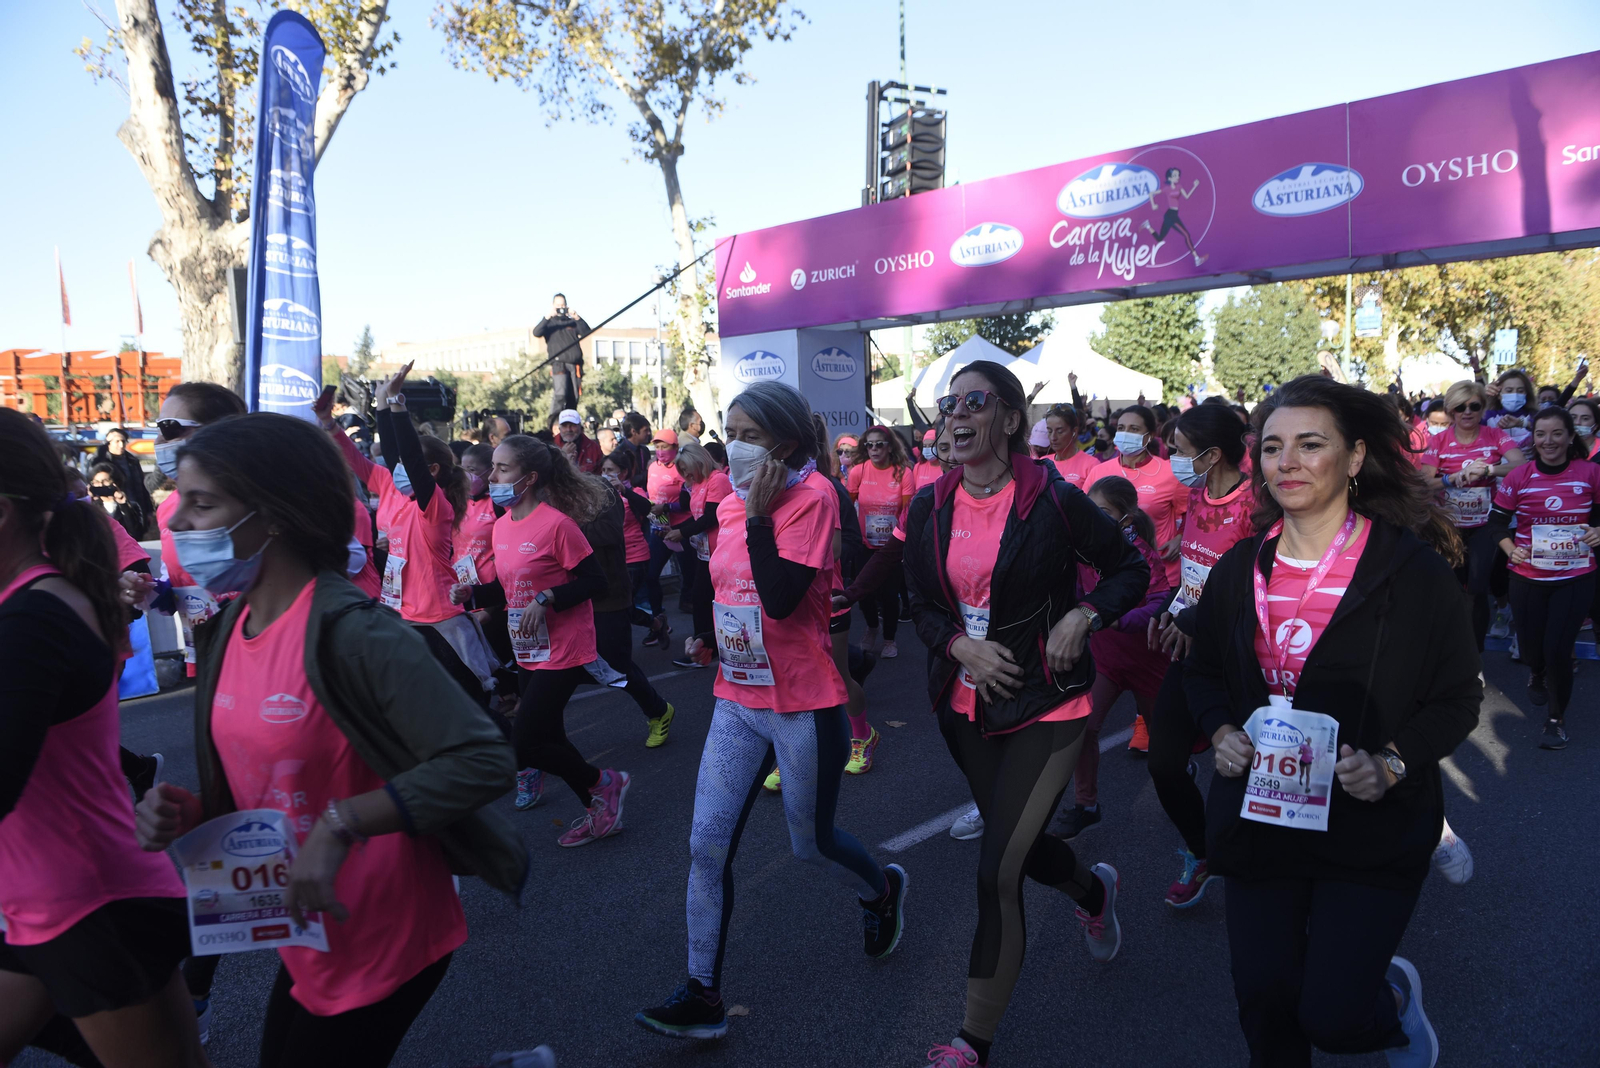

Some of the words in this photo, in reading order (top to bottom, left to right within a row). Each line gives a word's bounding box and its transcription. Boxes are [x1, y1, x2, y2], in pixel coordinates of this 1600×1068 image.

[1402, 149, 1519, 188] OYSHO
[1066, 182, 1150, 210] ASTURIANA
[1261, 182, 1355, 208] ASTURIANA
[1049, 217, 1133, 249] Carrera
[957, 240, 1017, 260] ASTURIANA
[1069, 245, 1085, 266] de
[1088, 243, 1100, 264] la
[1097, 233, 1166, 281] Mujer
[874, 250, 935, 275] OYSHO
[811, 264, 856, 284] ZURICH
[726, 281, 771, 299] Santander
[738, 365, 782, 378] ASTURIANA
[815, 359, 854, 373] ASTURIANA
[1531, 516, 1578, 525] ZURICH
[1550, 542, 1573, 551] 016
[515, 580, 533, 588] POR
[736, 579, 757, 590] POR
[1186, 584, 1201, 601] 016
[511, 629, 531, 640] 016
[725, 635, 745, 652] 016
[1252, 751, 1298, 777] 016
[1254, 776, 1280, 790] 2549
[1258, 789, 1270, 798] DE
[1270, 792, 1282, 801] LA
[1282, 794, 1309, 804] MUJER
[1297, 812, 1320, 821] ZURICH
[231, 863, 289, 891] 016
[250, 894, 282, 907] 1635
[219, 910, 259, 923] CARRERA
[260, 908, 274, 919] DE
[275, 907, 287, 917] LA
[198, 930, 247, 945] OYSHO
